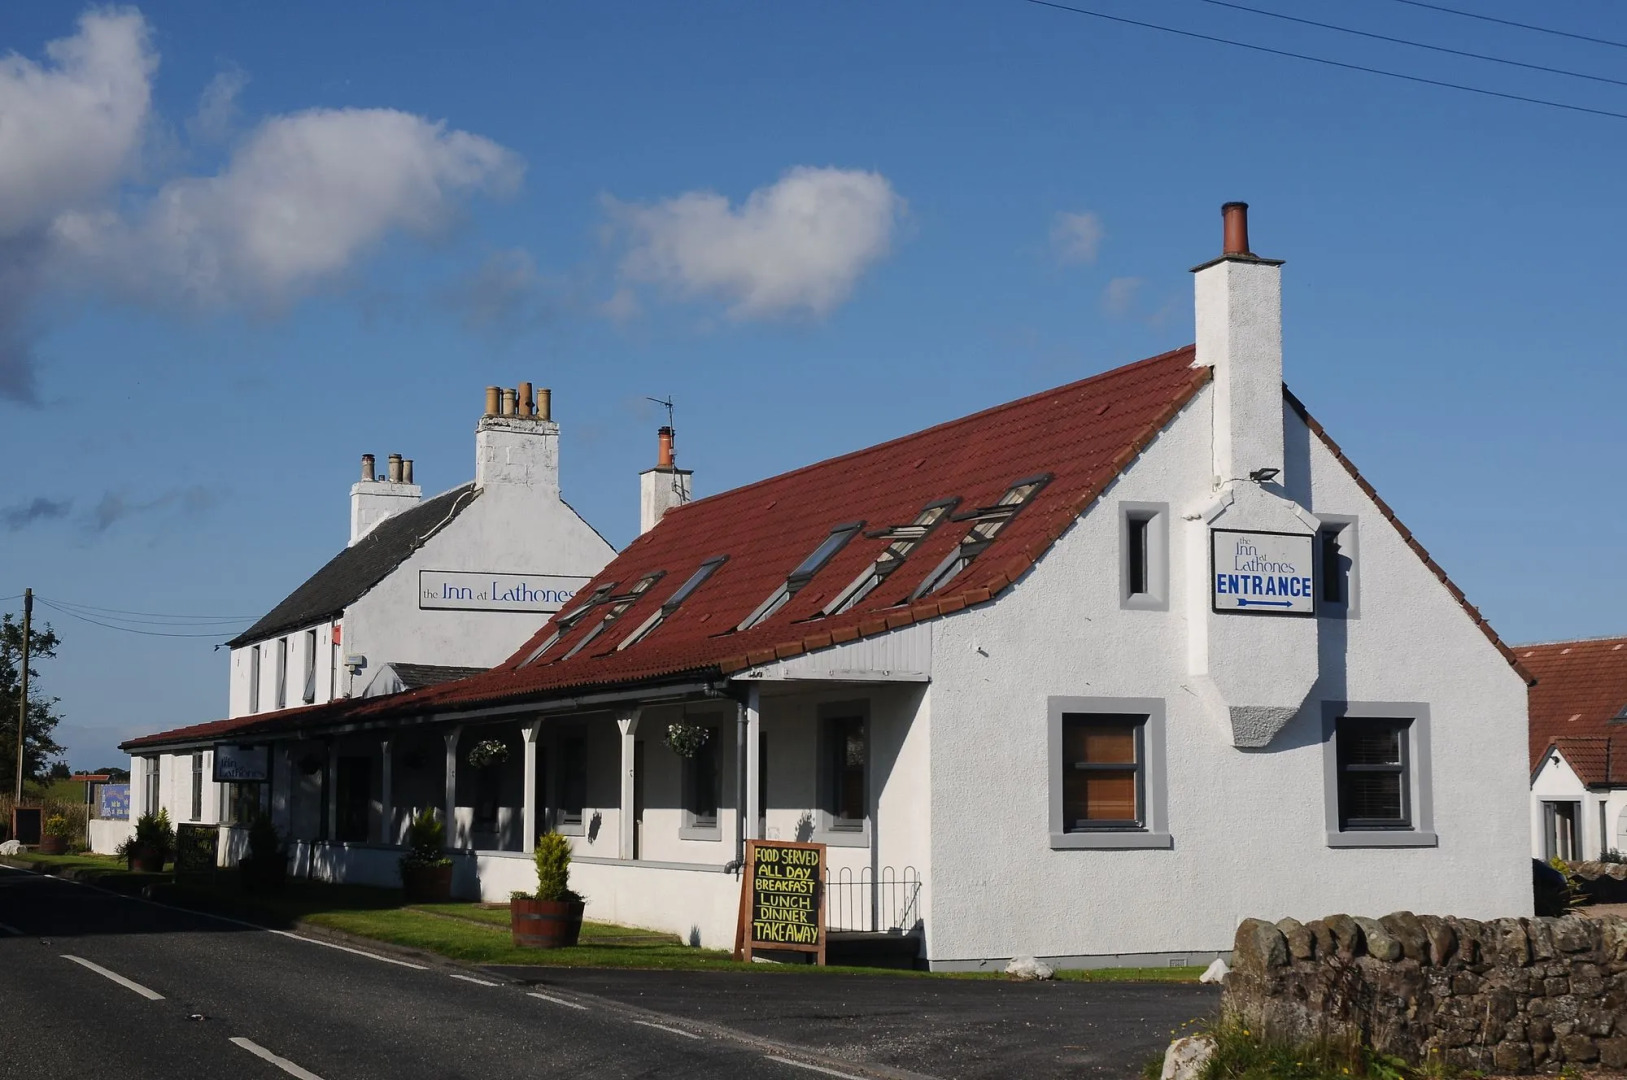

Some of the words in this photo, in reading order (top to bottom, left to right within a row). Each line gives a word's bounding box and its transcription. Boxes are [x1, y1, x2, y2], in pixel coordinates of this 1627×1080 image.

[1236, 542, 1257, 555] Inn
[1239, 536, 1251, 545] the
[1234, 555, 1295, 573] Lathones
[423, 589, 438, 599] the
[443, 582, 472, 599] Inn
[476, 590, 487, 600] at
[1217, 573, 1311, 597] ENTRANCE
[755, 847, 779, 862] FOOD
[781, 849, 819, 866] SERVED
[758, 864, 782, 877] ALL
[786, 866, 811, 879] DAY
[755, 879, 815, 893] BREAKFAST
[760, 893, 810, 909] LUNCH
[760, 907, 808, 923] DINNER
[754, 922, 818, 944] TAKEAWAY
